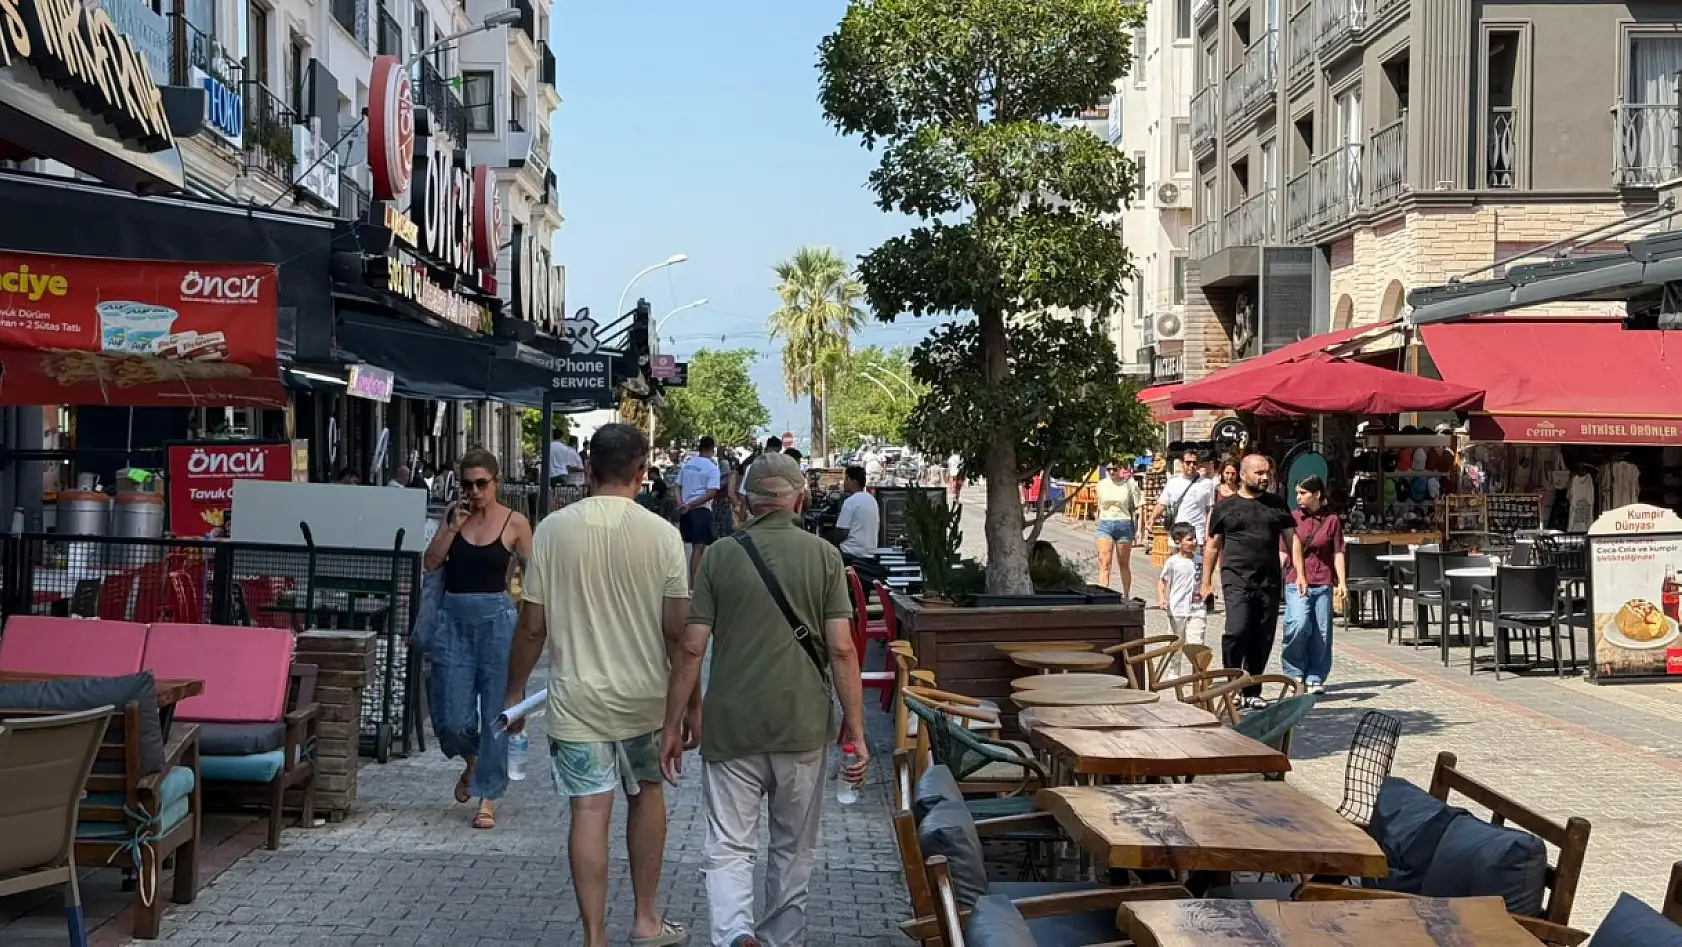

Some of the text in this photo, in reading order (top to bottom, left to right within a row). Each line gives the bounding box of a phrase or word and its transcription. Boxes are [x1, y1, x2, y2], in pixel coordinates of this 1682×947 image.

[0, 264, 69, 301] ciye
[552, 376, 605, 389] SERVICE
[1580, 422, 1627, 436] BİTKİSEL
[1630, 423, 1677, 437] ÜRÜNLER
[189, 487, 226, 500] Tavuk
[1627, 509, 1665, 521] Kumpir
[1615, 520, 1656, 532] Dünyası
